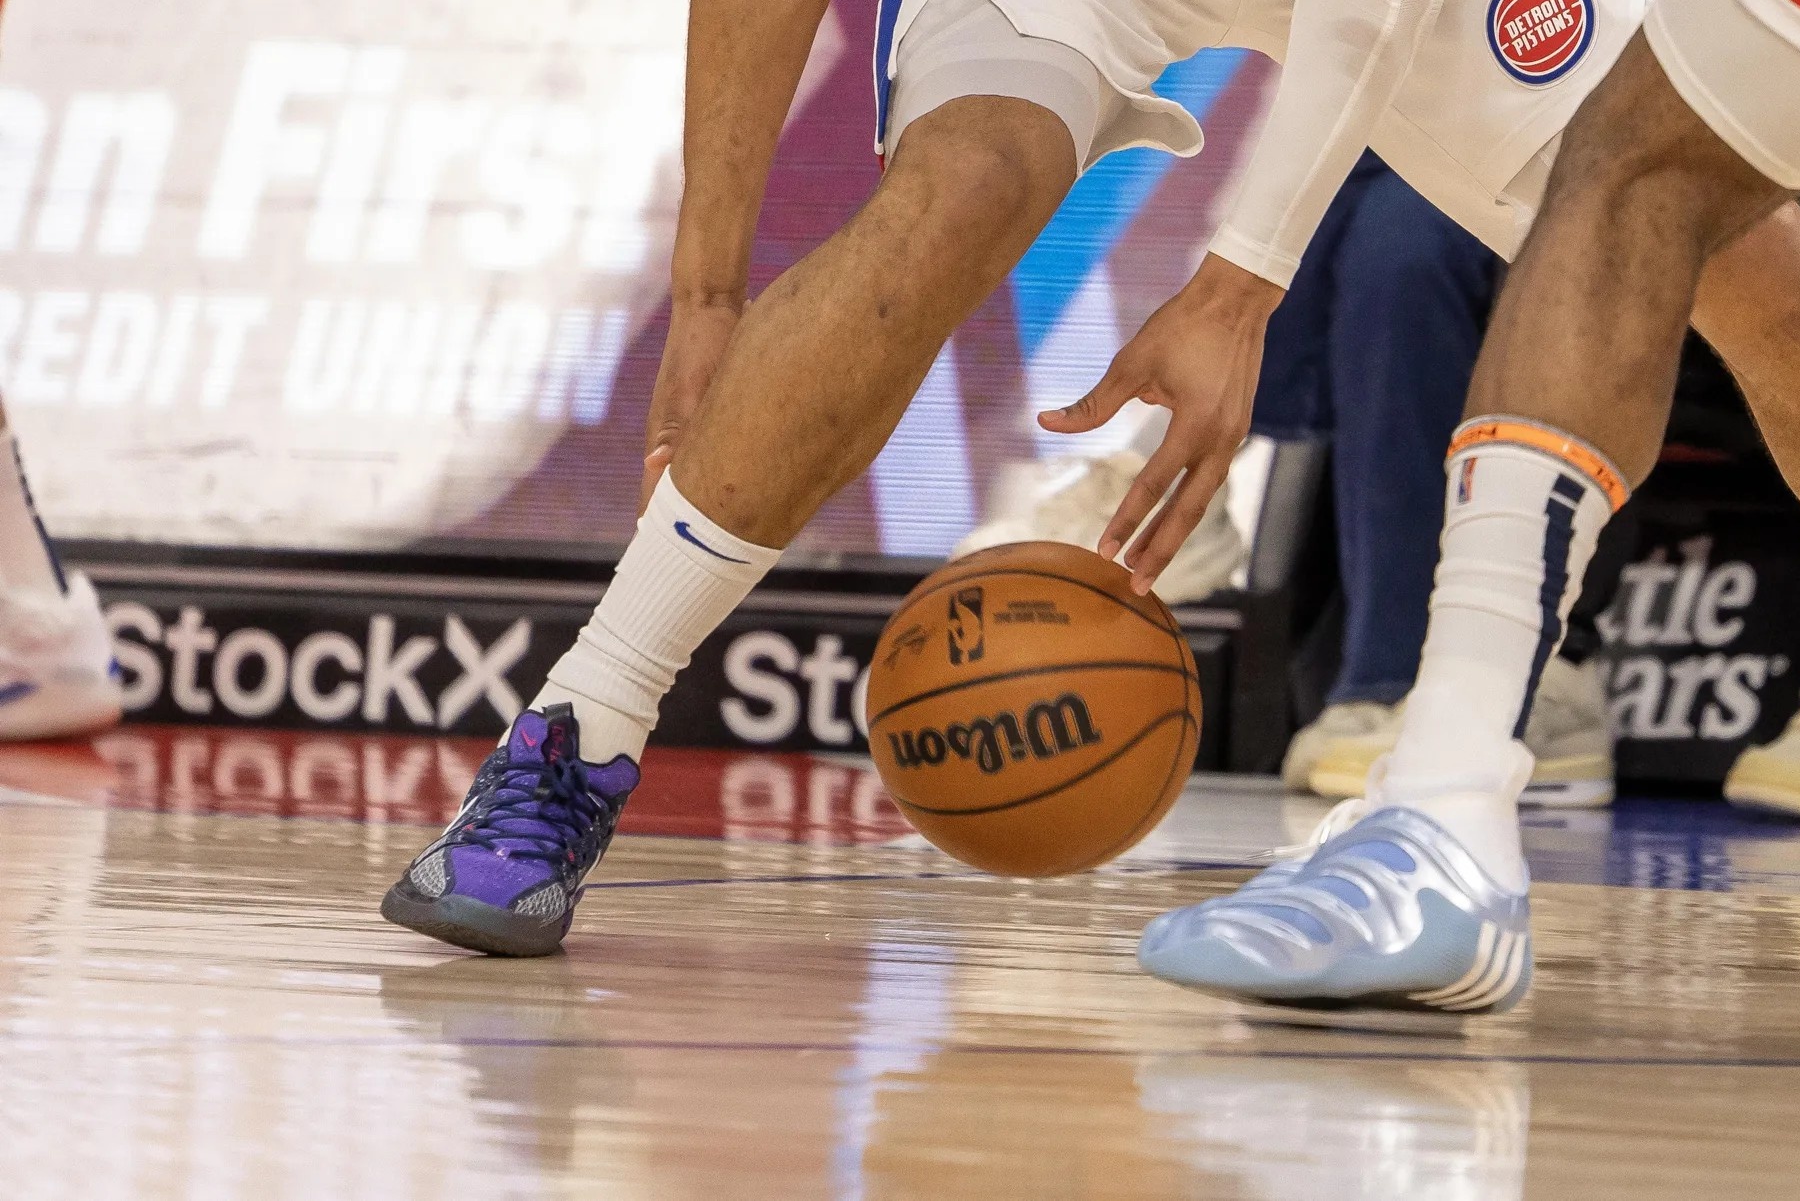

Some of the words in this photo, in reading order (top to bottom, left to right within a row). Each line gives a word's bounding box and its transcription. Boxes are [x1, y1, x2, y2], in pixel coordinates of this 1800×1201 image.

[1511, 9, 1575, 57] PISTONS
[196, 40, 686, 272] First
[281, 298, 630, 426] UNION
[106, 601, 531, 728] StockX
[887, 692, 1102, 775] Wilson
